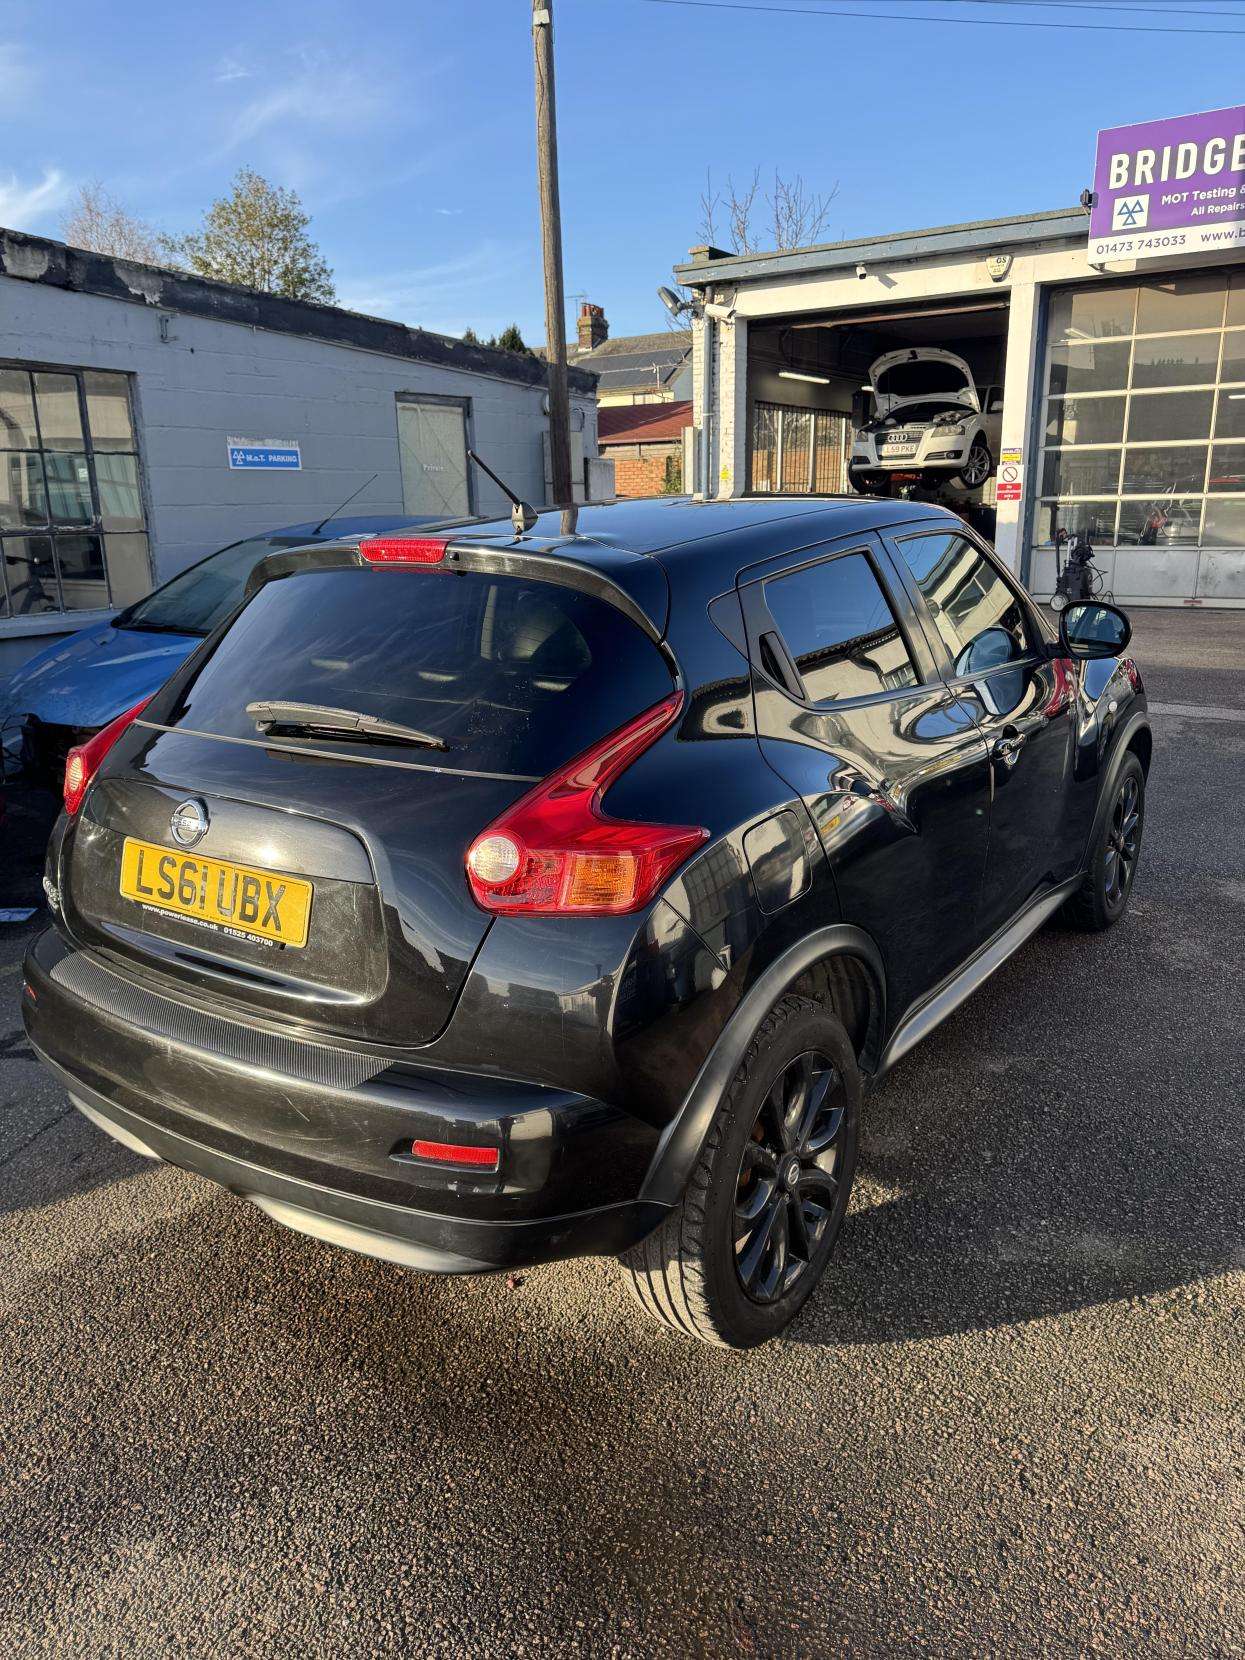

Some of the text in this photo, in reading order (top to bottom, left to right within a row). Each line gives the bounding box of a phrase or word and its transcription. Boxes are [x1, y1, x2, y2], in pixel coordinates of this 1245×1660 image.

[1108, 133, 1245, 190] BRIDGE
[1161, 192, 1189, 206] MOT
[1192, 186, 1237, 202] Testing
[1190, 200, 1245, 217] All Repairs
[1096, 240, 1133, 255] 01473
[1137, 234, 1187, 250] 743033
[268, 454, 298, 463] PARKING
[136, 849, 287, 932] LS61 UBX
[141, 903, 219, 931] www.powerlease.co.uk
[223, 926, 246, 939] 01525
[246, 932, 274, 947] 403700
